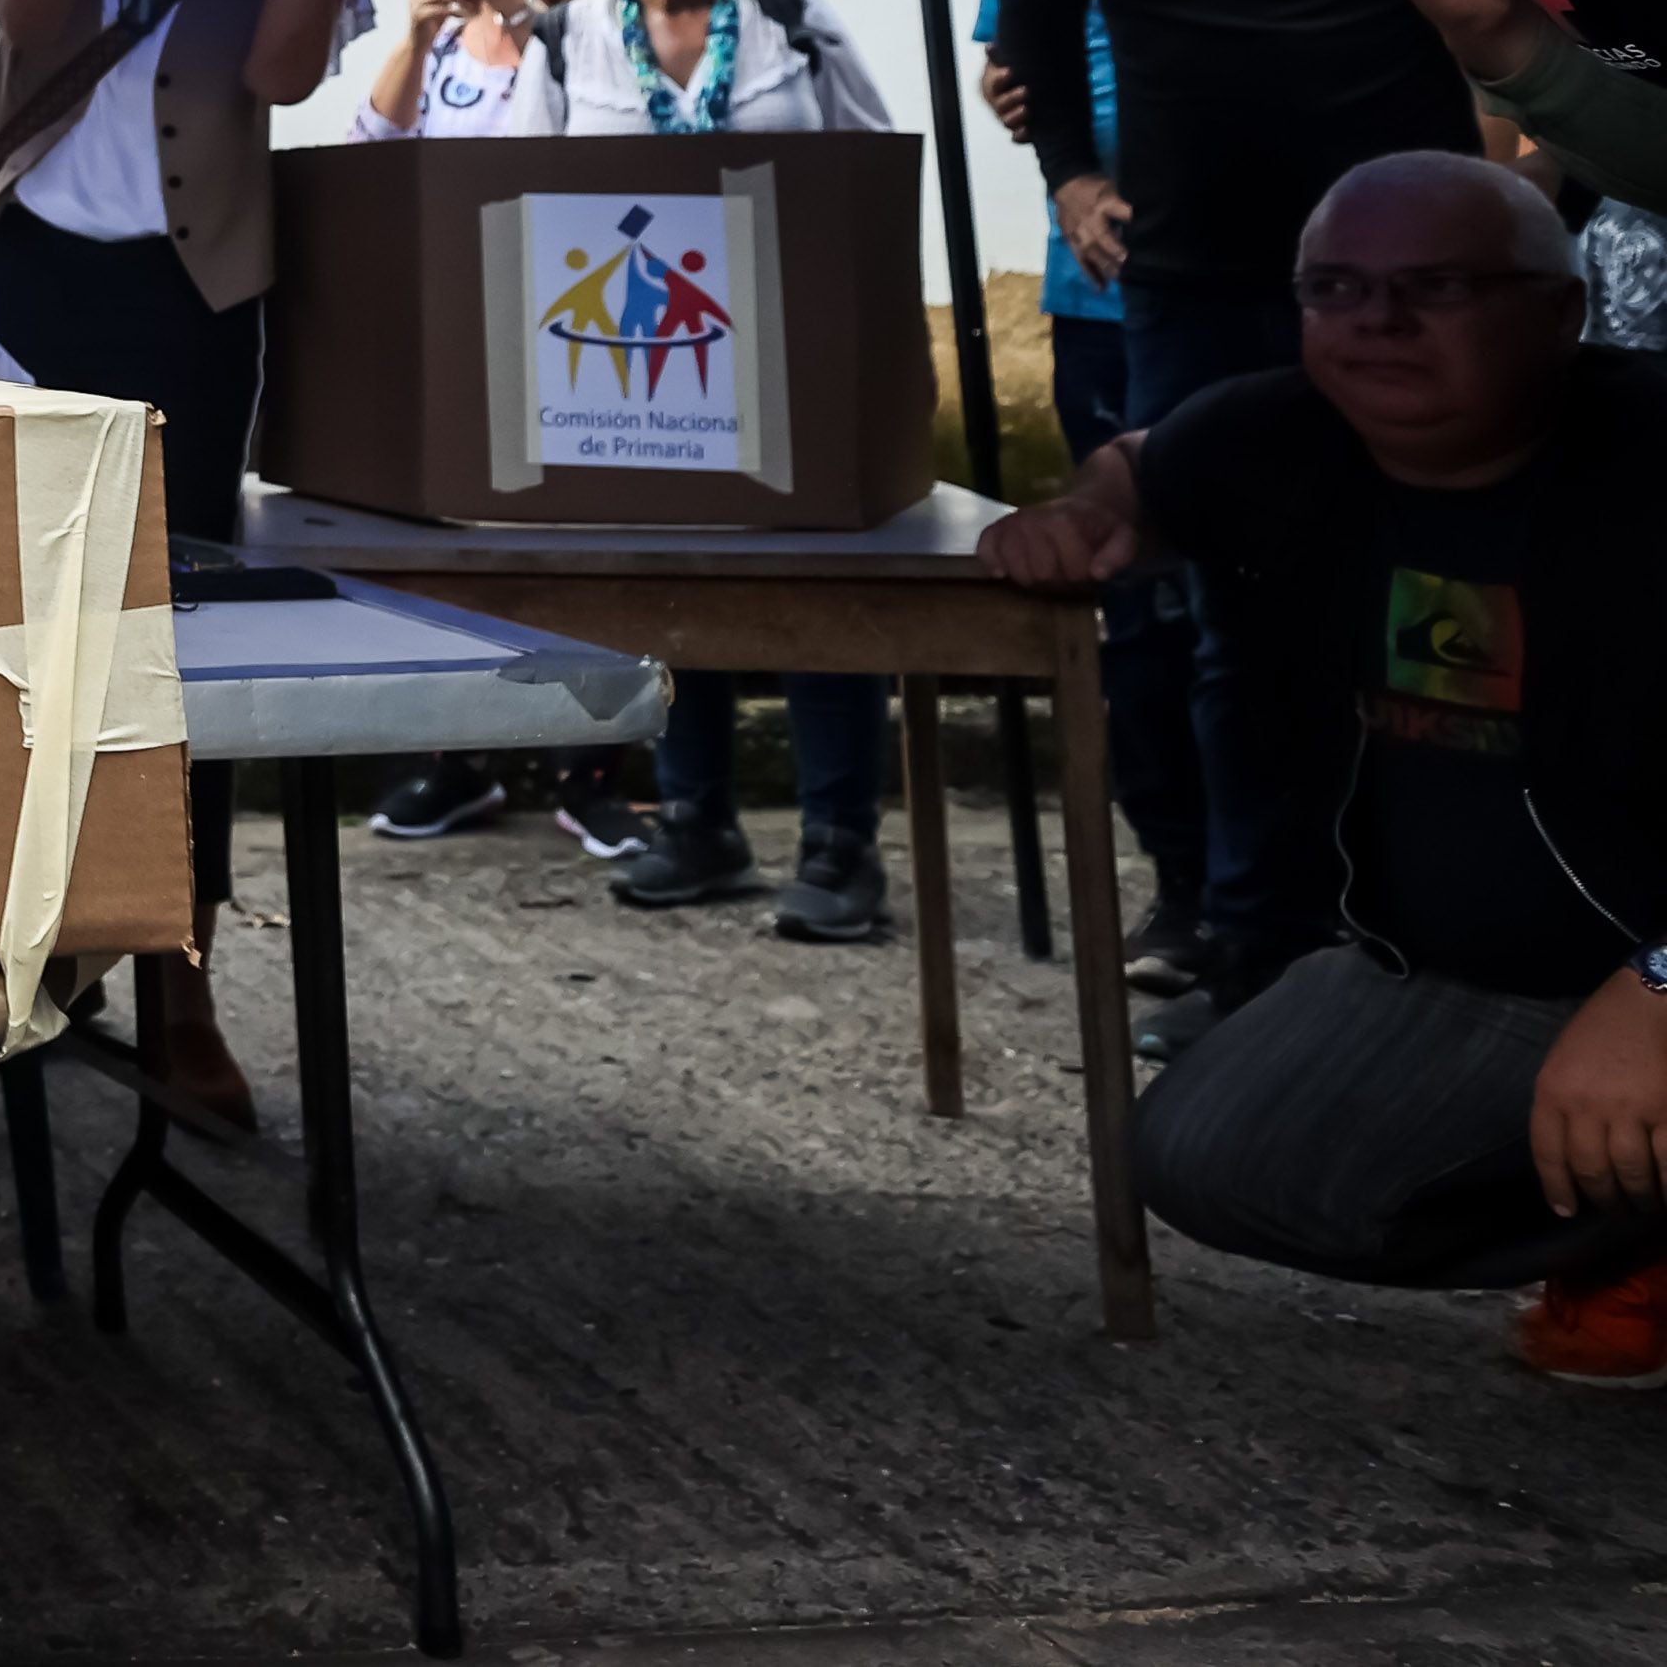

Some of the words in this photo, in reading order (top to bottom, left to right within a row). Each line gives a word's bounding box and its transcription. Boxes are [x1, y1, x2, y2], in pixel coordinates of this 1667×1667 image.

[540, 406, 641, 429] Comisión
[579, 435, 607, 457] de
[613, 436, 705, 460] Primaria
